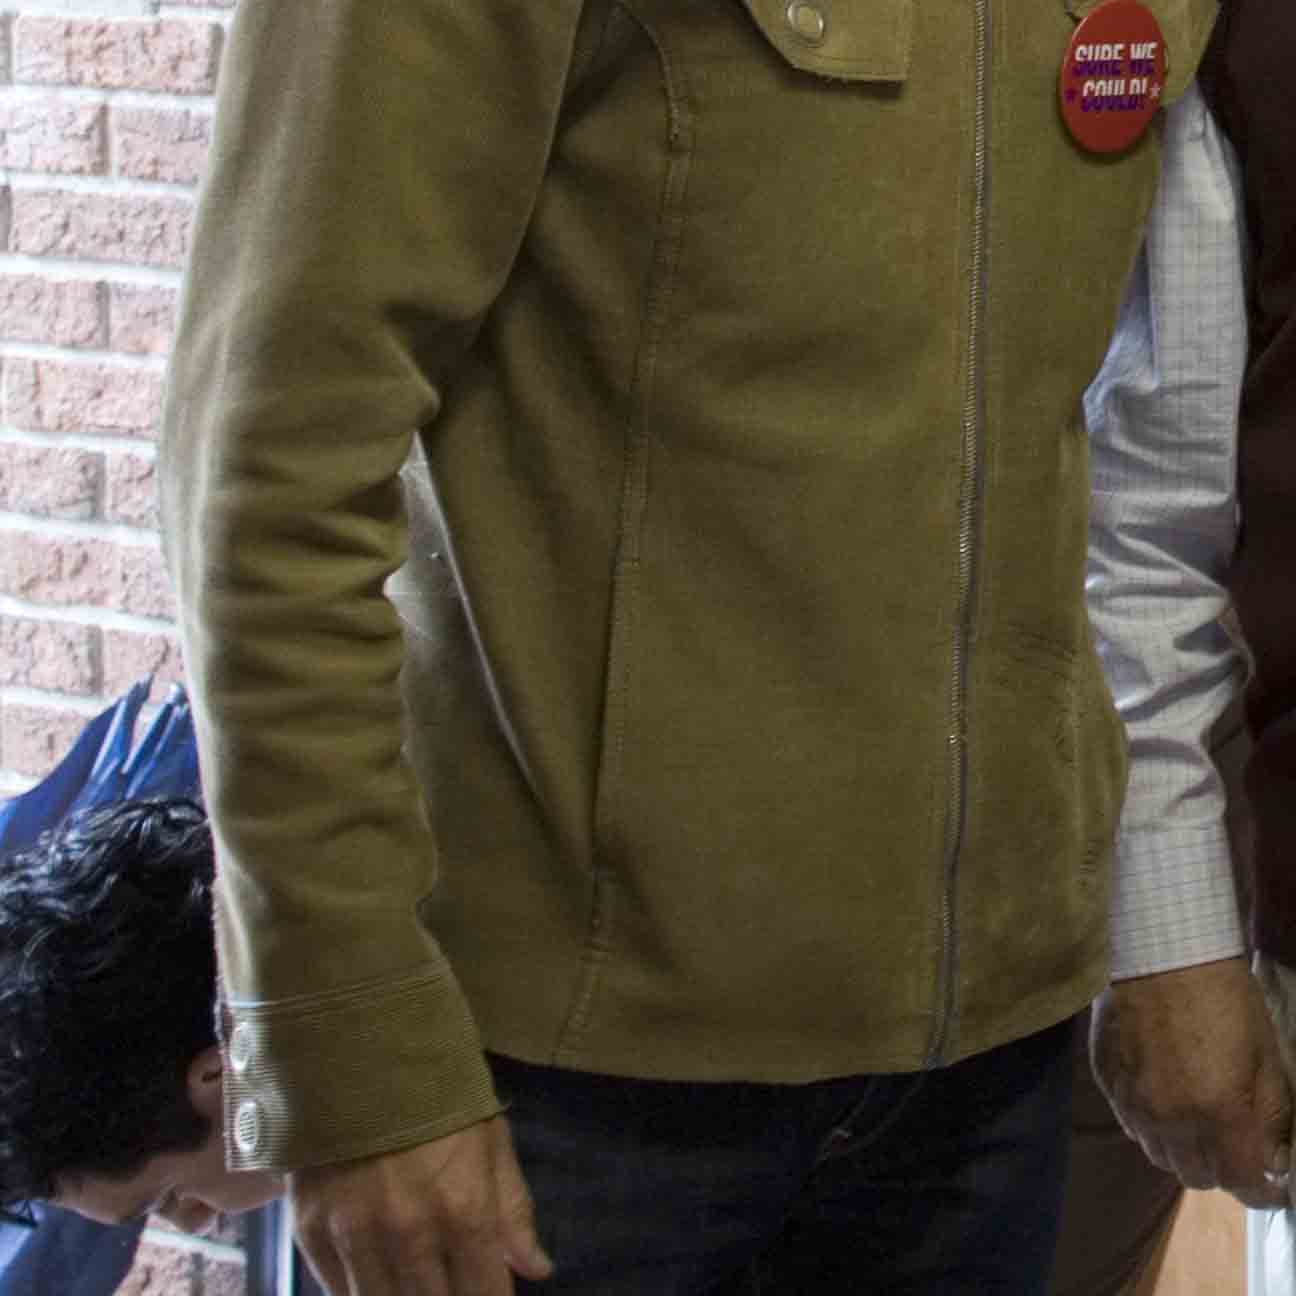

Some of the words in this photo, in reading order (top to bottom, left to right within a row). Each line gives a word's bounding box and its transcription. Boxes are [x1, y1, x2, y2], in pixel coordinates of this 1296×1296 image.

[1072, 43, 1124, 77] SURE
[1128, 41, 1158, 77] WE
[1080, 77, 1149, 113] COULD!
